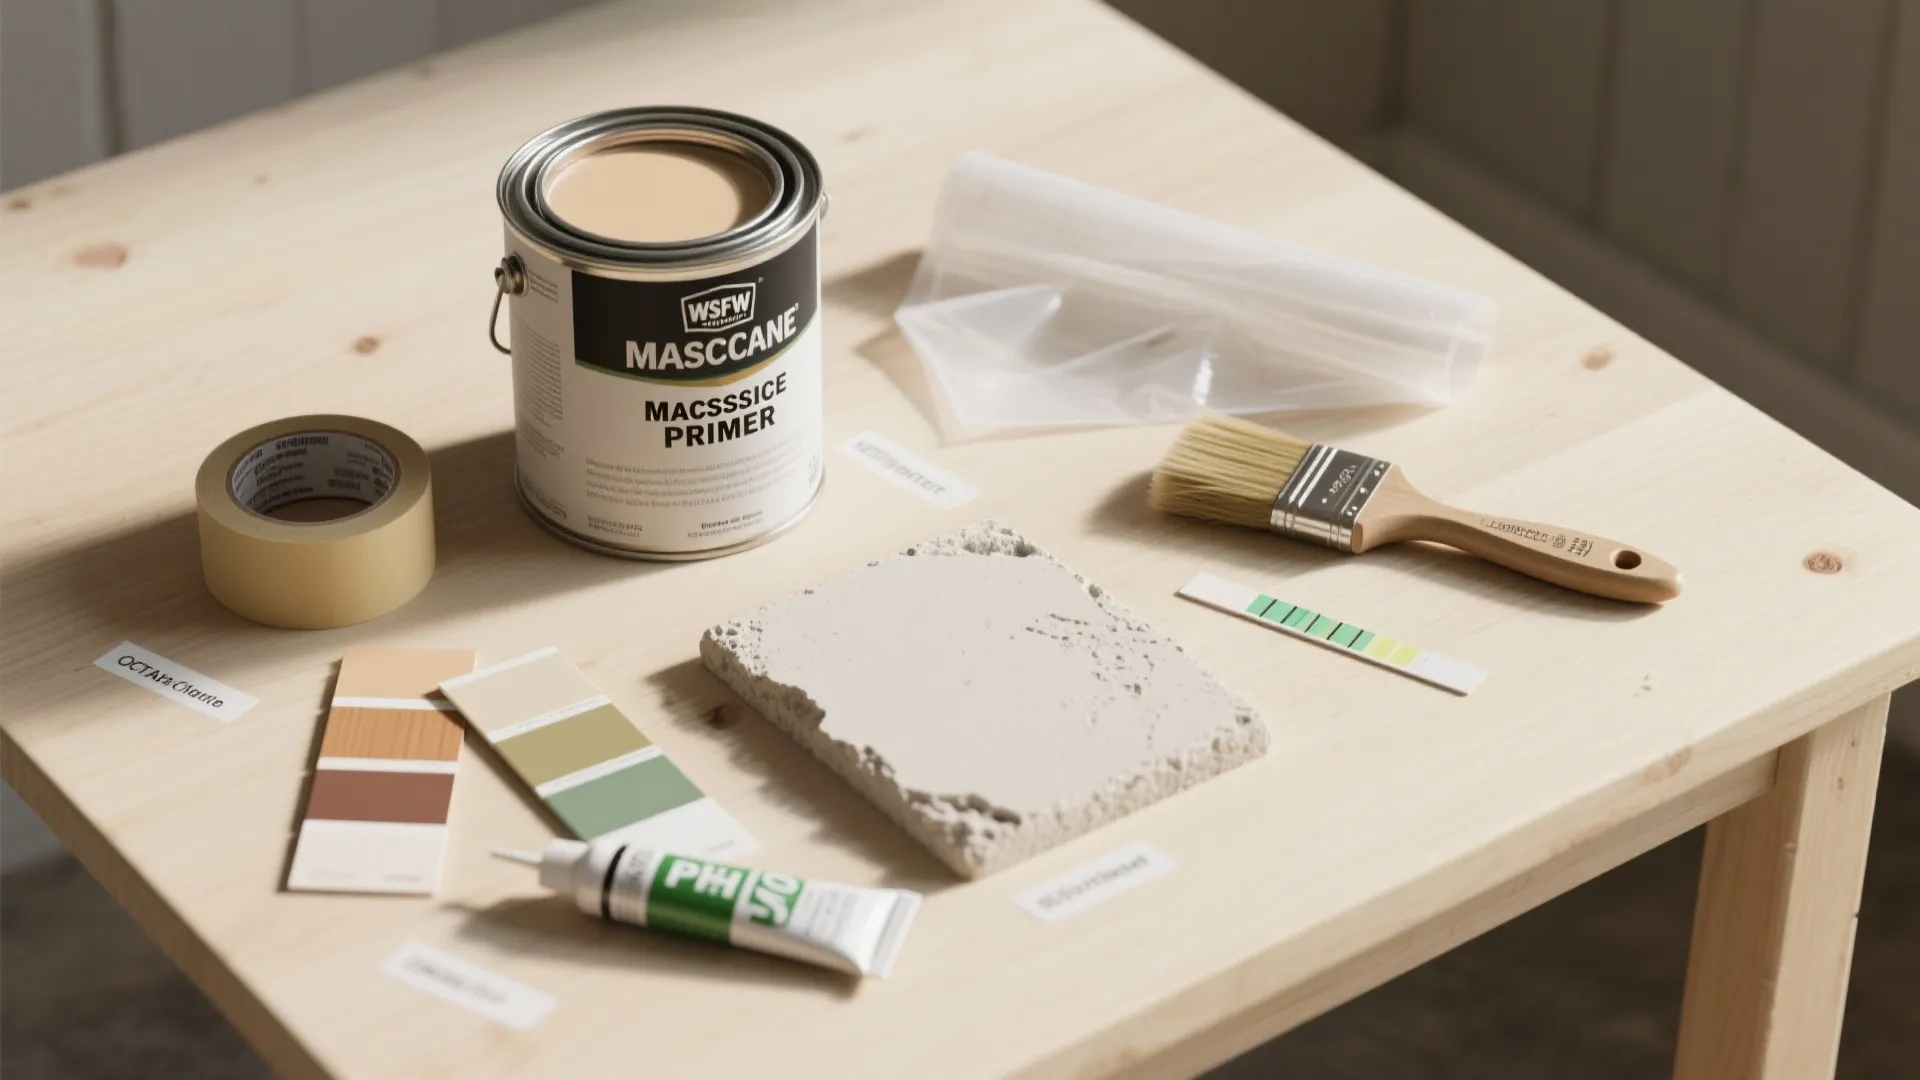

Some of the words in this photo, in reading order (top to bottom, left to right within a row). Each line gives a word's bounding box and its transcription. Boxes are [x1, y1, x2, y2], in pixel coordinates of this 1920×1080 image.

[687, 290, 751, 323] WSFW
[645, 371, 787, 423] MACSSSICE
[664, 405, 776, 448] PRIMER
